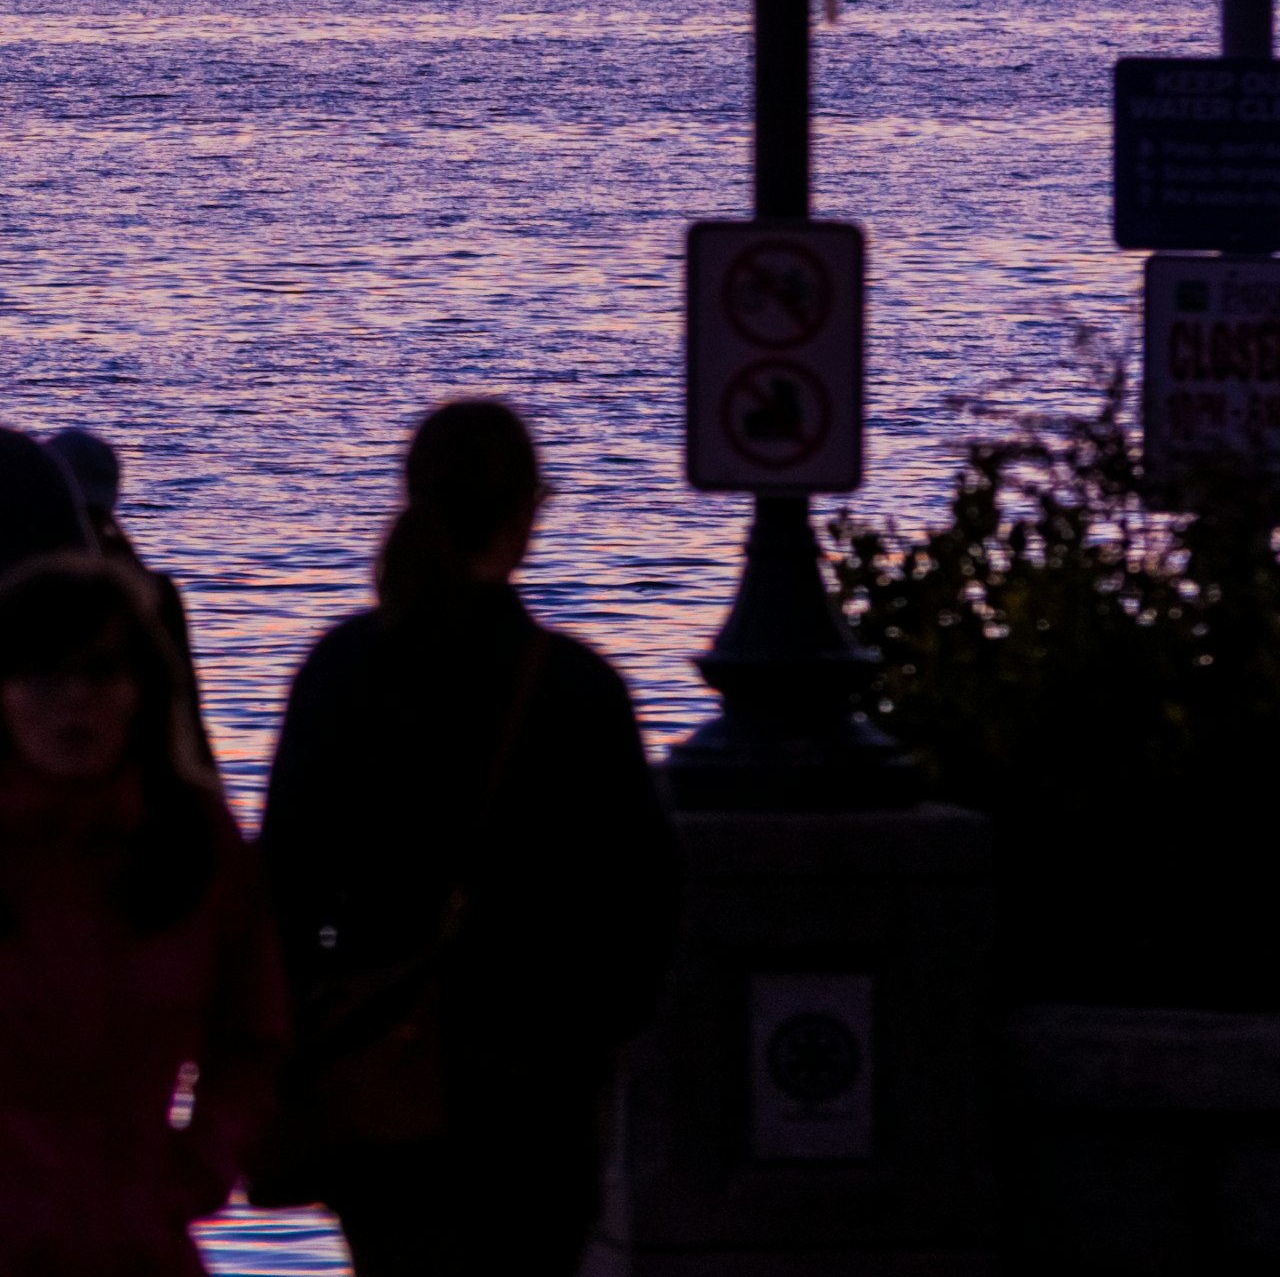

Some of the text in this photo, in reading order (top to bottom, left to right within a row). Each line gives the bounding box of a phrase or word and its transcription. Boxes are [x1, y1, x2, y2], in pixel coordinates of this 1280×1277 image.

[1154, 70, 1235, 93] KEEP
[1128, 95, 1233, 119] WATER
[1169, 321, 1280, 382] CLOSE
